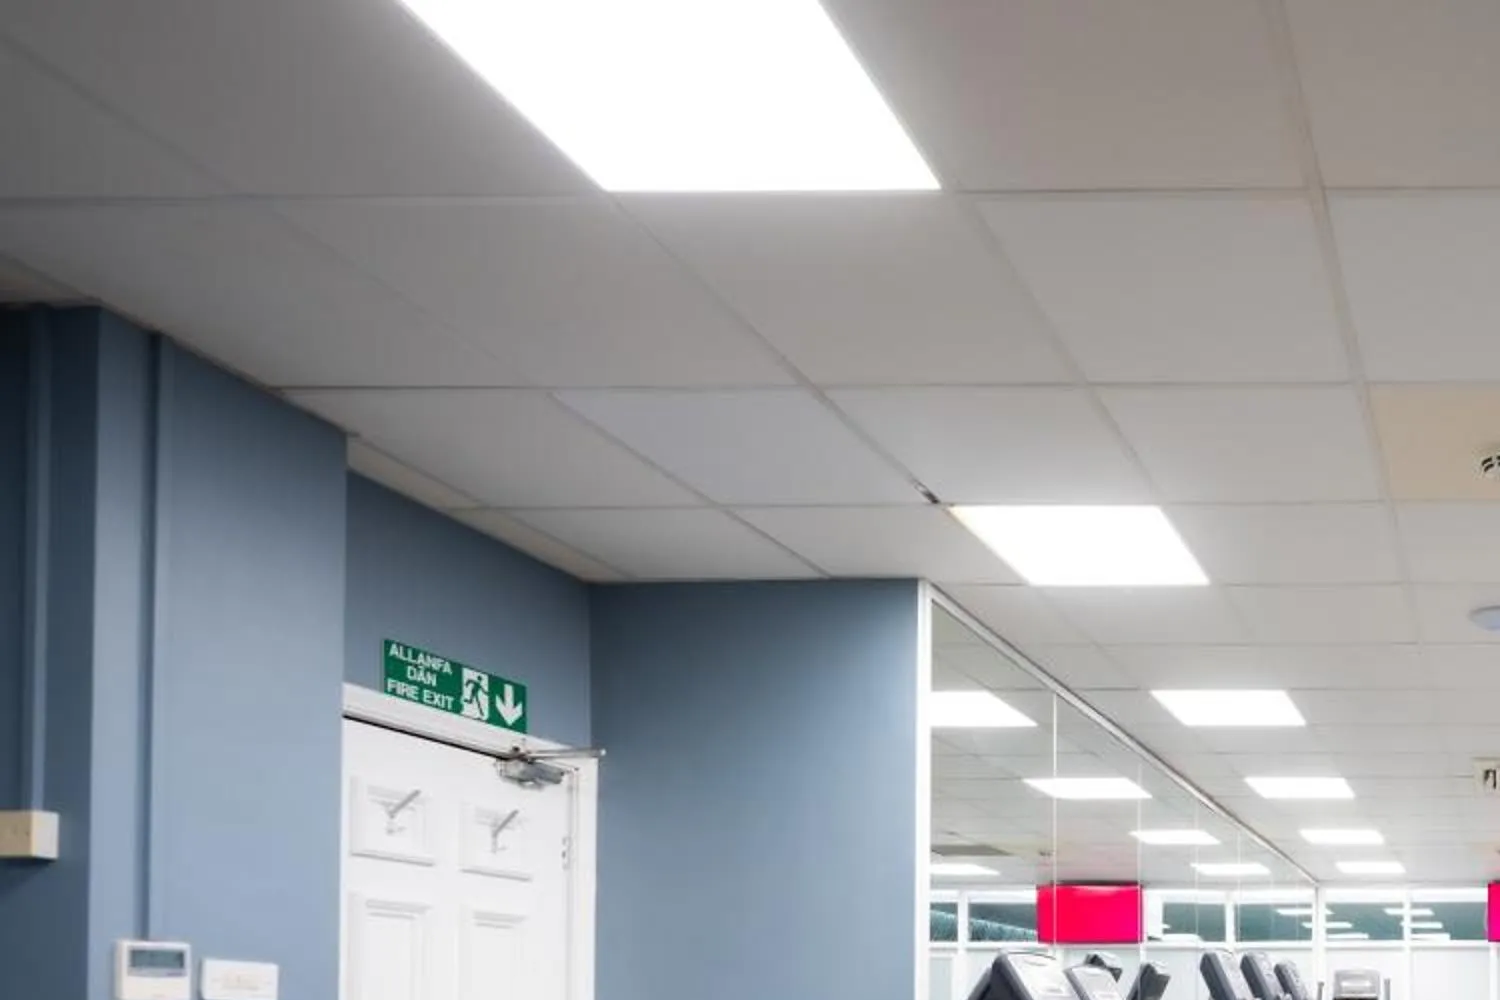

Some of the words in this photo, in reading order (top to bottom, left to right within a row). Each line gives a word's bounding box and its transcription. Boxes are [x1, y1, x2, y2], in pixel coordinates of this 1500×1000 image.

[388, 643, 453, 675] ALLANFA
[386, 677, 419, 701] FIRE
[423, 689, 455, 710] EXIT
